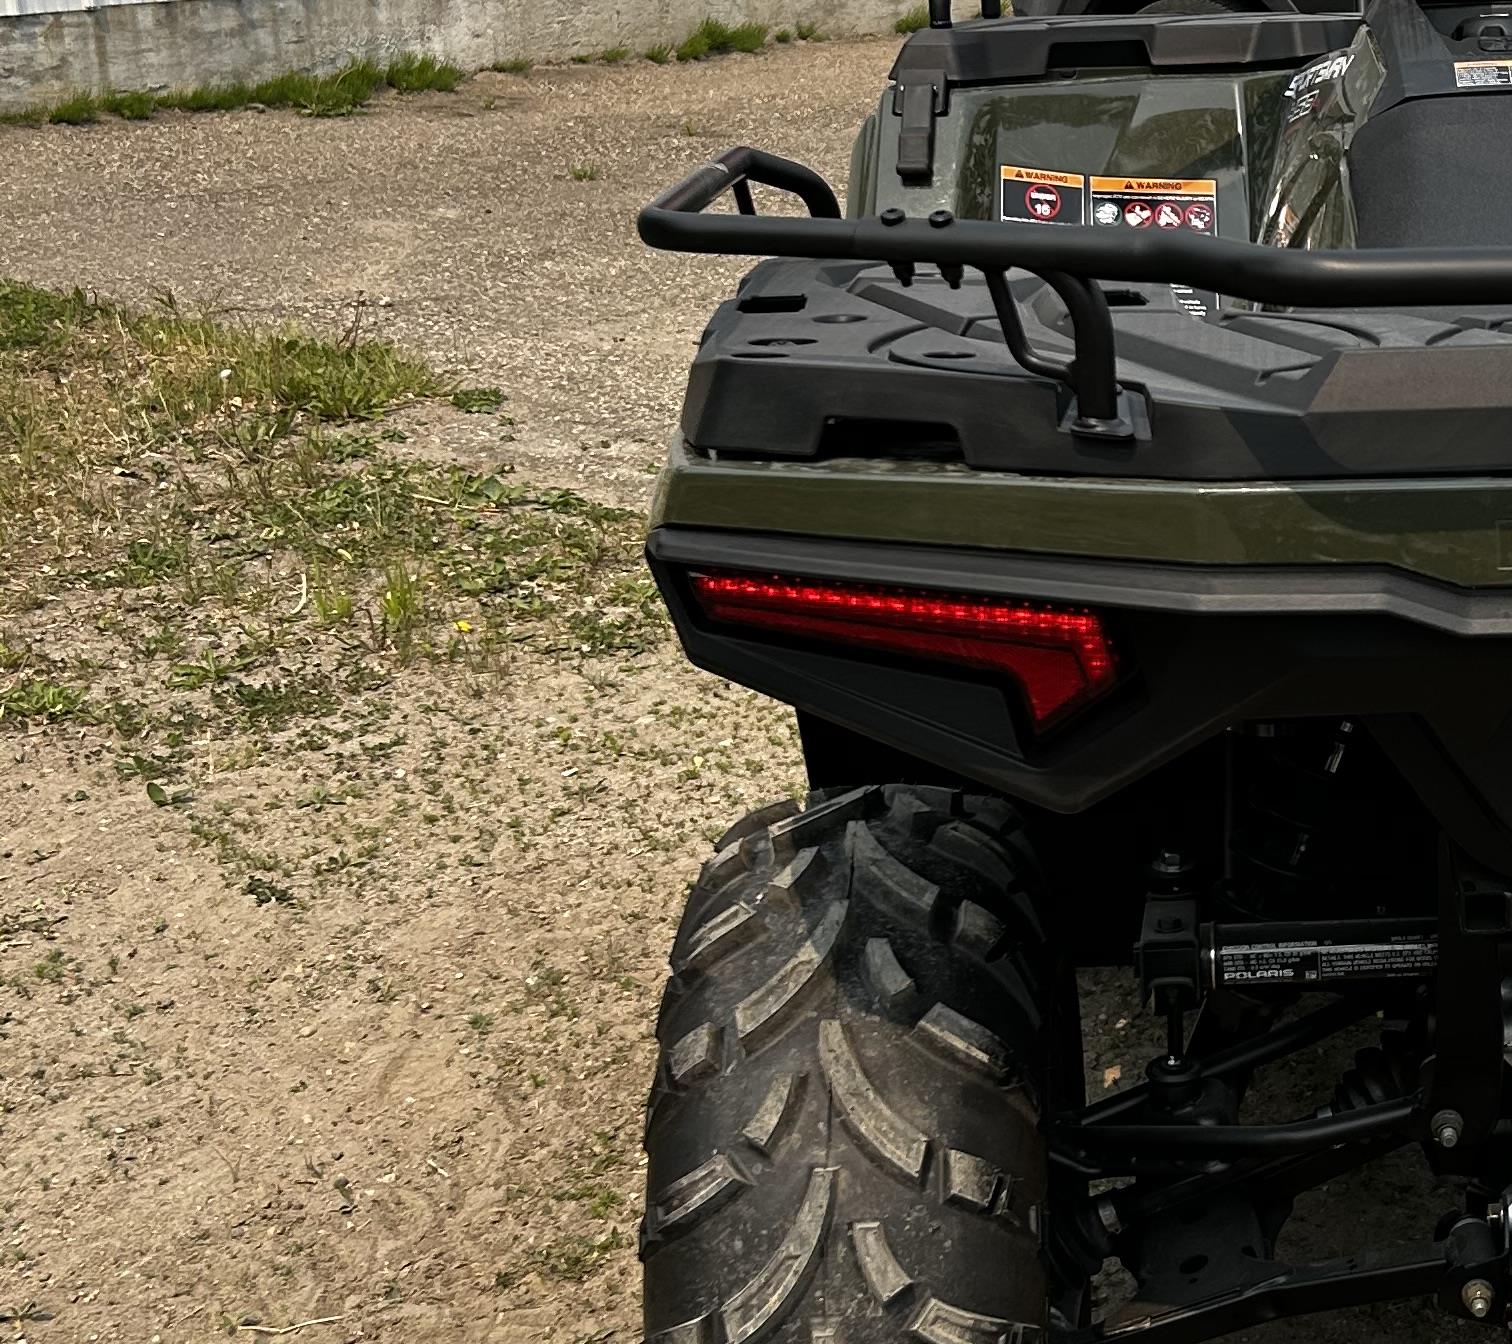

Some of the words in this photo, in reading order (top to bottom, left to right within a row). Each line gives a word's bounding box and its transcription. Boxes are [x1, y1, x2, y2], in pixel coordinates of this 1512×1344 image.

[1025, 171, 1069, 184] WARNING
[1136, 181, 1182, 191] WARNING
[1224, 968, 1295, 981] POLARIS
